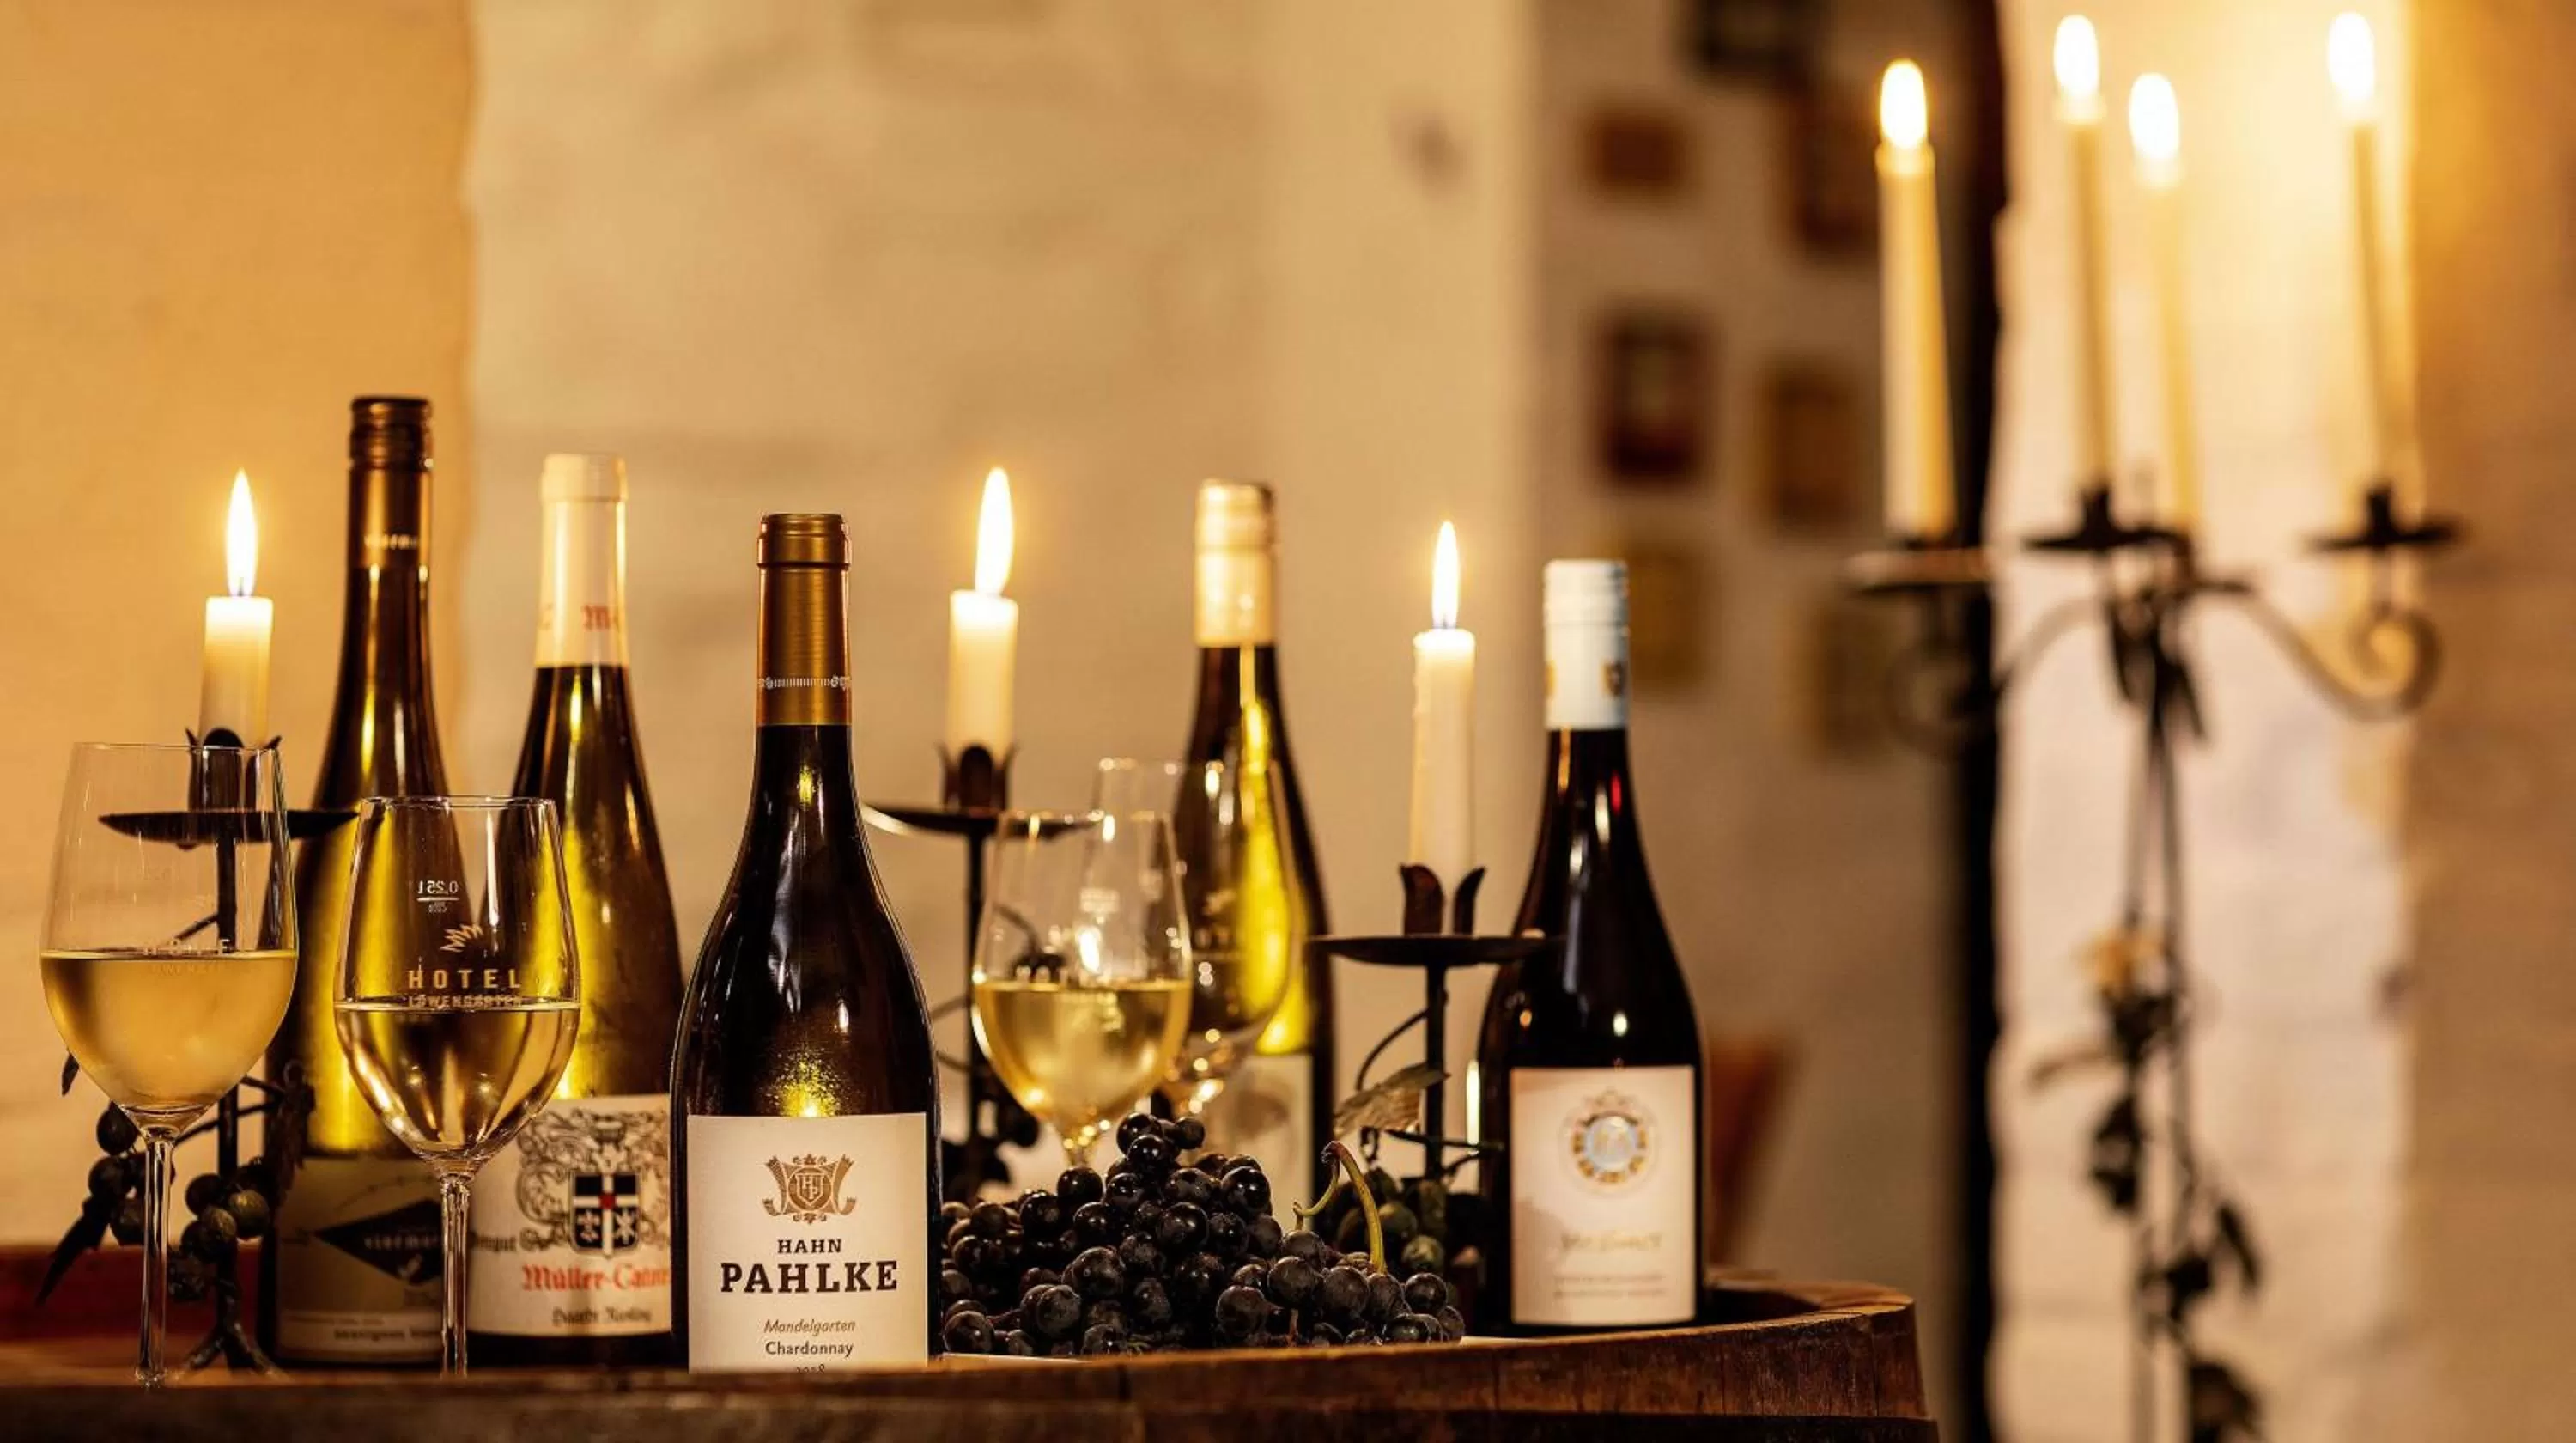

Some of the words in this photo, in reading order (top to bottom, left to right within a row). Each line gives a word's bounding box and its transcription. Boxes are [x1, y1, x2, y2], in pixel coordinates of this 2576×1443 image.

[408, 969, 521, 989] HOTEL
[777, 1239, 842, 1254] HAHN
[720, 1260, 898, 1294] PAHLKE
[763, 1318, 856, 1336] Mandelgarten
[765, 1340, 854, 1357] Chardonnay
